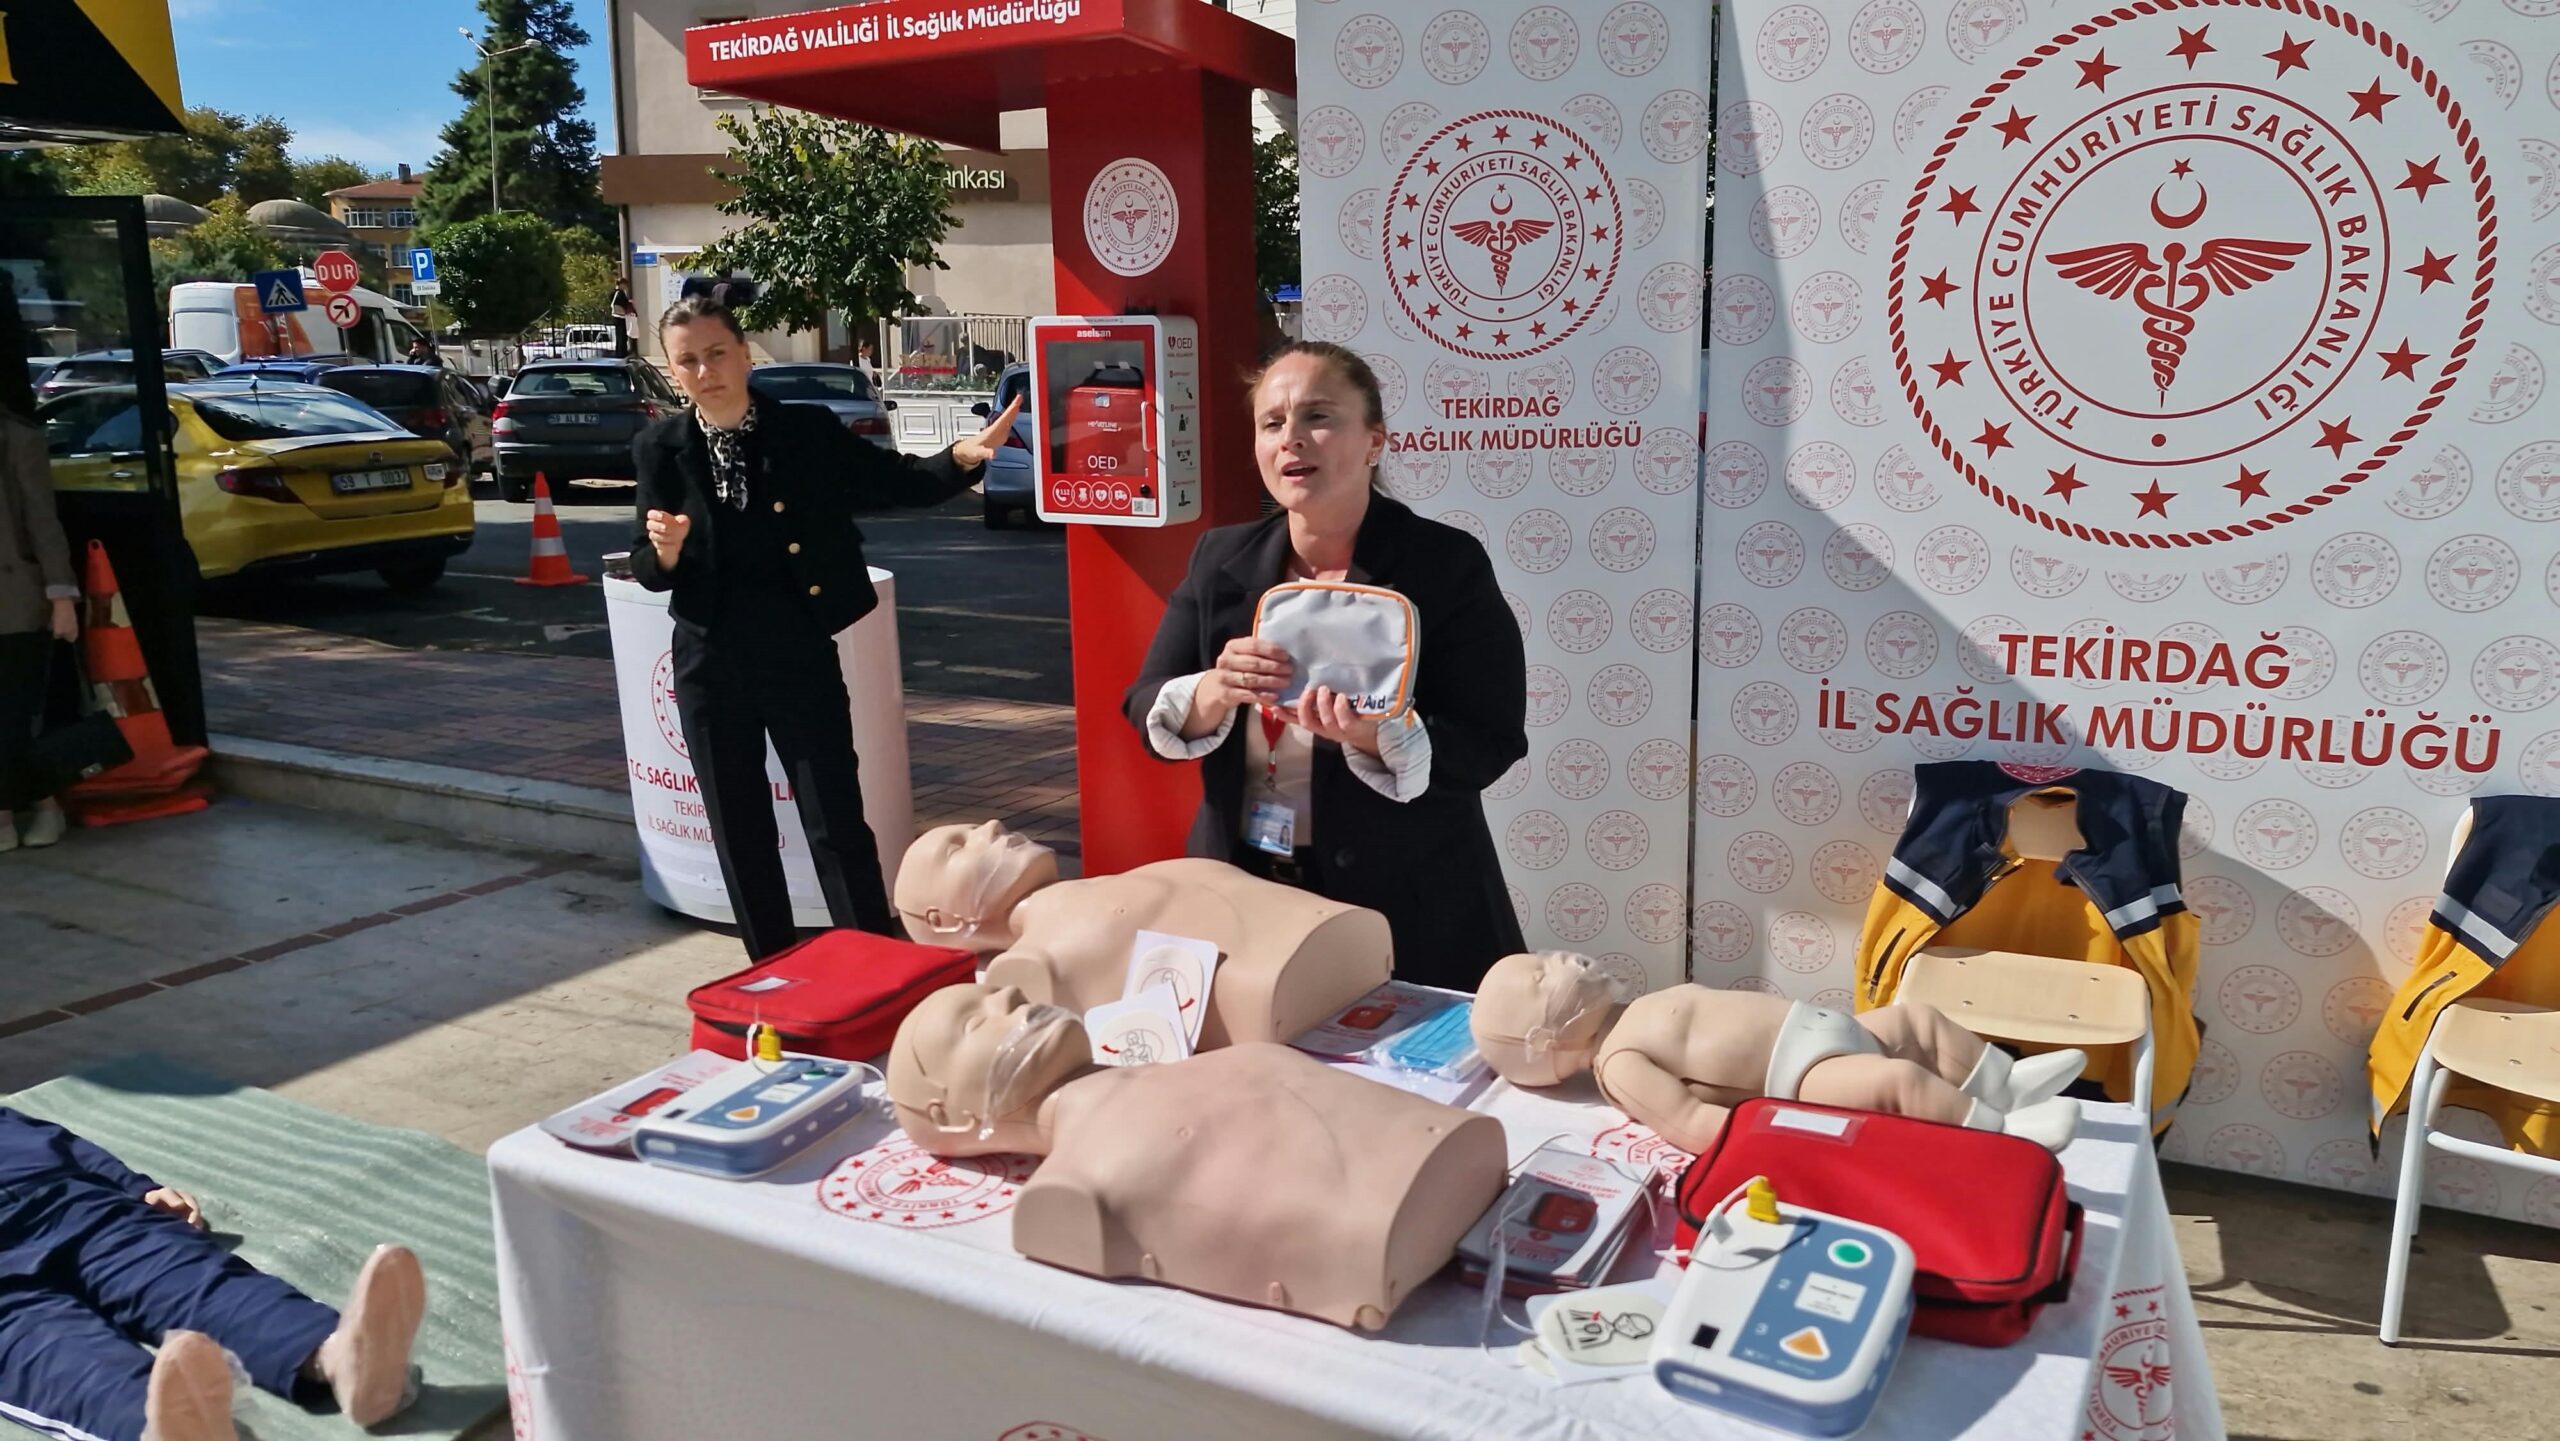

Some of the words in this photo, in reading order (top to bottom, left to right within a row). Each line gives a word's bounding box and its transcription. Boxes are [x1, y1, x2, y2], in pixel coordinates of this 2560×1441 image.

[709, 27, 799, 61] TEKİRDAĞ
[903, 10, 964, 40] Sağlık
[2231, 105, 2357, 206] SAĞLIK
[926, 164, 1005, 189] ankası
[1427, 156, 1514, 236] CUMHURİYETİ
[1519, 161, 1569, 206] SAĞLIK
[1992, 95, 2217, 278] CUMHURİYETİ
[318, 263, 355, 281] DUR
[415, 252, 428, 278] P
[1427, 243, 1469, 307] TÜRKİYE
[1538, 209, 1578, 301] BAKANLIĞI
[1076, 328, 1111, 338] aselsan
[2256, 213, 2369, 420] BAKANLIĞI
[1177, 337, 1192, 349] OED
[1989, 294, 2077, 429] TÜRKİYE
[1441, 390, 1561, 420] TEKİRDAĞ
[1389, 425, 1473, 453] SAĞLIK
[1480, 420, 1641, 451] MÜDÜRLÜĞÜ
[1087, 455, 1118, 470] OED
[2000, 626, 2290, 690] TEKİRDAĞ
[1818, 678, 1857, 731] İL
[1875, 685, 2068, 746] SAĞLIK
[2085, 696, 2502, 773] MÜDÜRLÜĞÜ
[630, 758, 646, 781] T.C.
[648, 767, 699, 794] SAĞLIK
[656, 819, 690, 839] SAĞLIK
[673, 800, 708, 818] TEKİR
